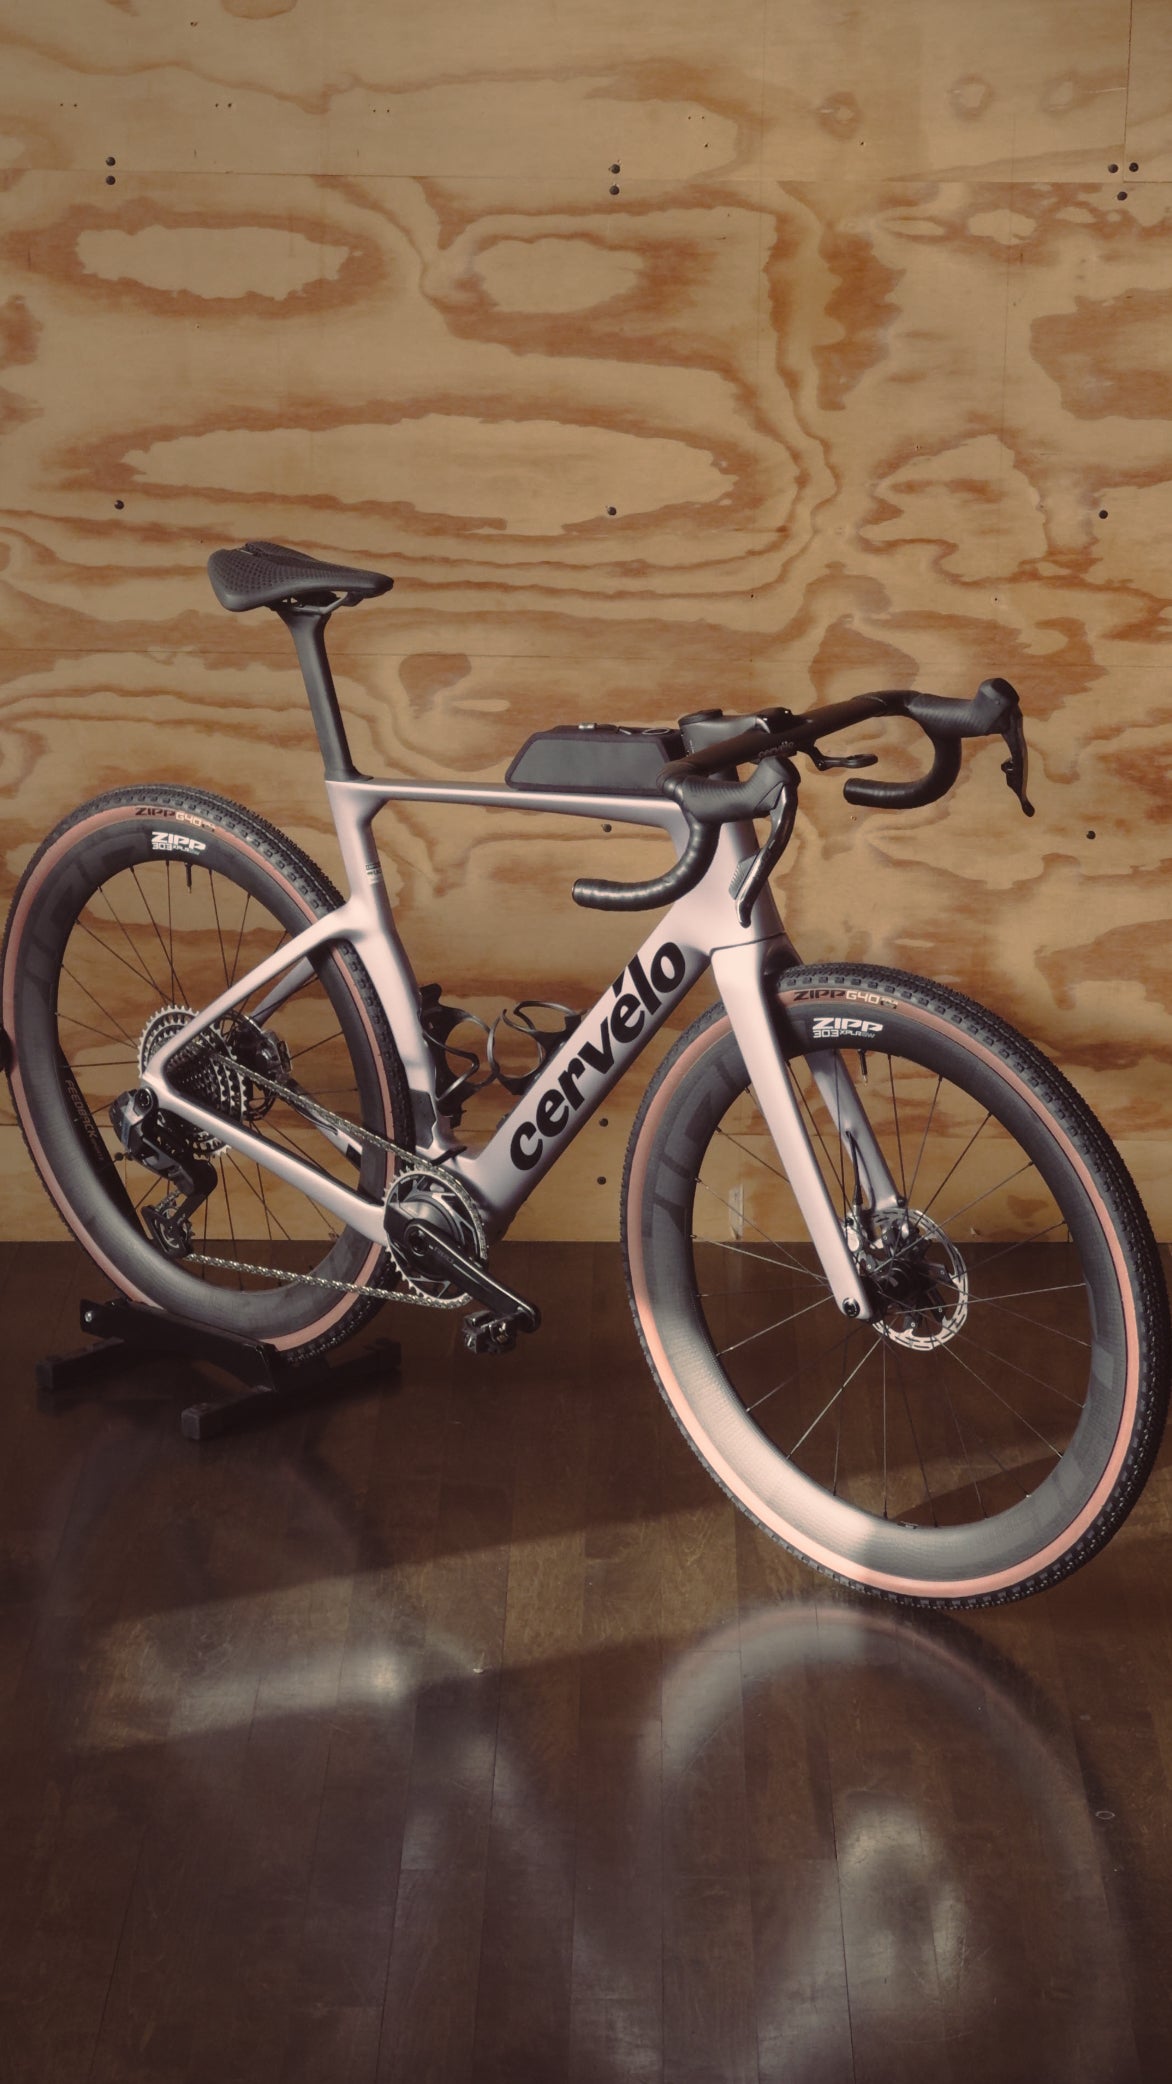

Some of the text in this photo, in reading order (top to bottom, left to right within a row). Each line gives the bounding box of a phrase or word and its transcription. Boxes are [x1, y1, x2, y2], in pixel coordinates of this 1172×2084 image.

[135, 807, 202, 826] ZIPP G40
[151, 831, 207, 851] ZIPP
[793, 989, 846, 1001] ZIPP
[845, 990, 880, 1005] G40
[812, 1017, 884, 1032] ZIPP
[812, 1029, 839, 1039] 303
[510, 941, 686, 1171] cervélo
